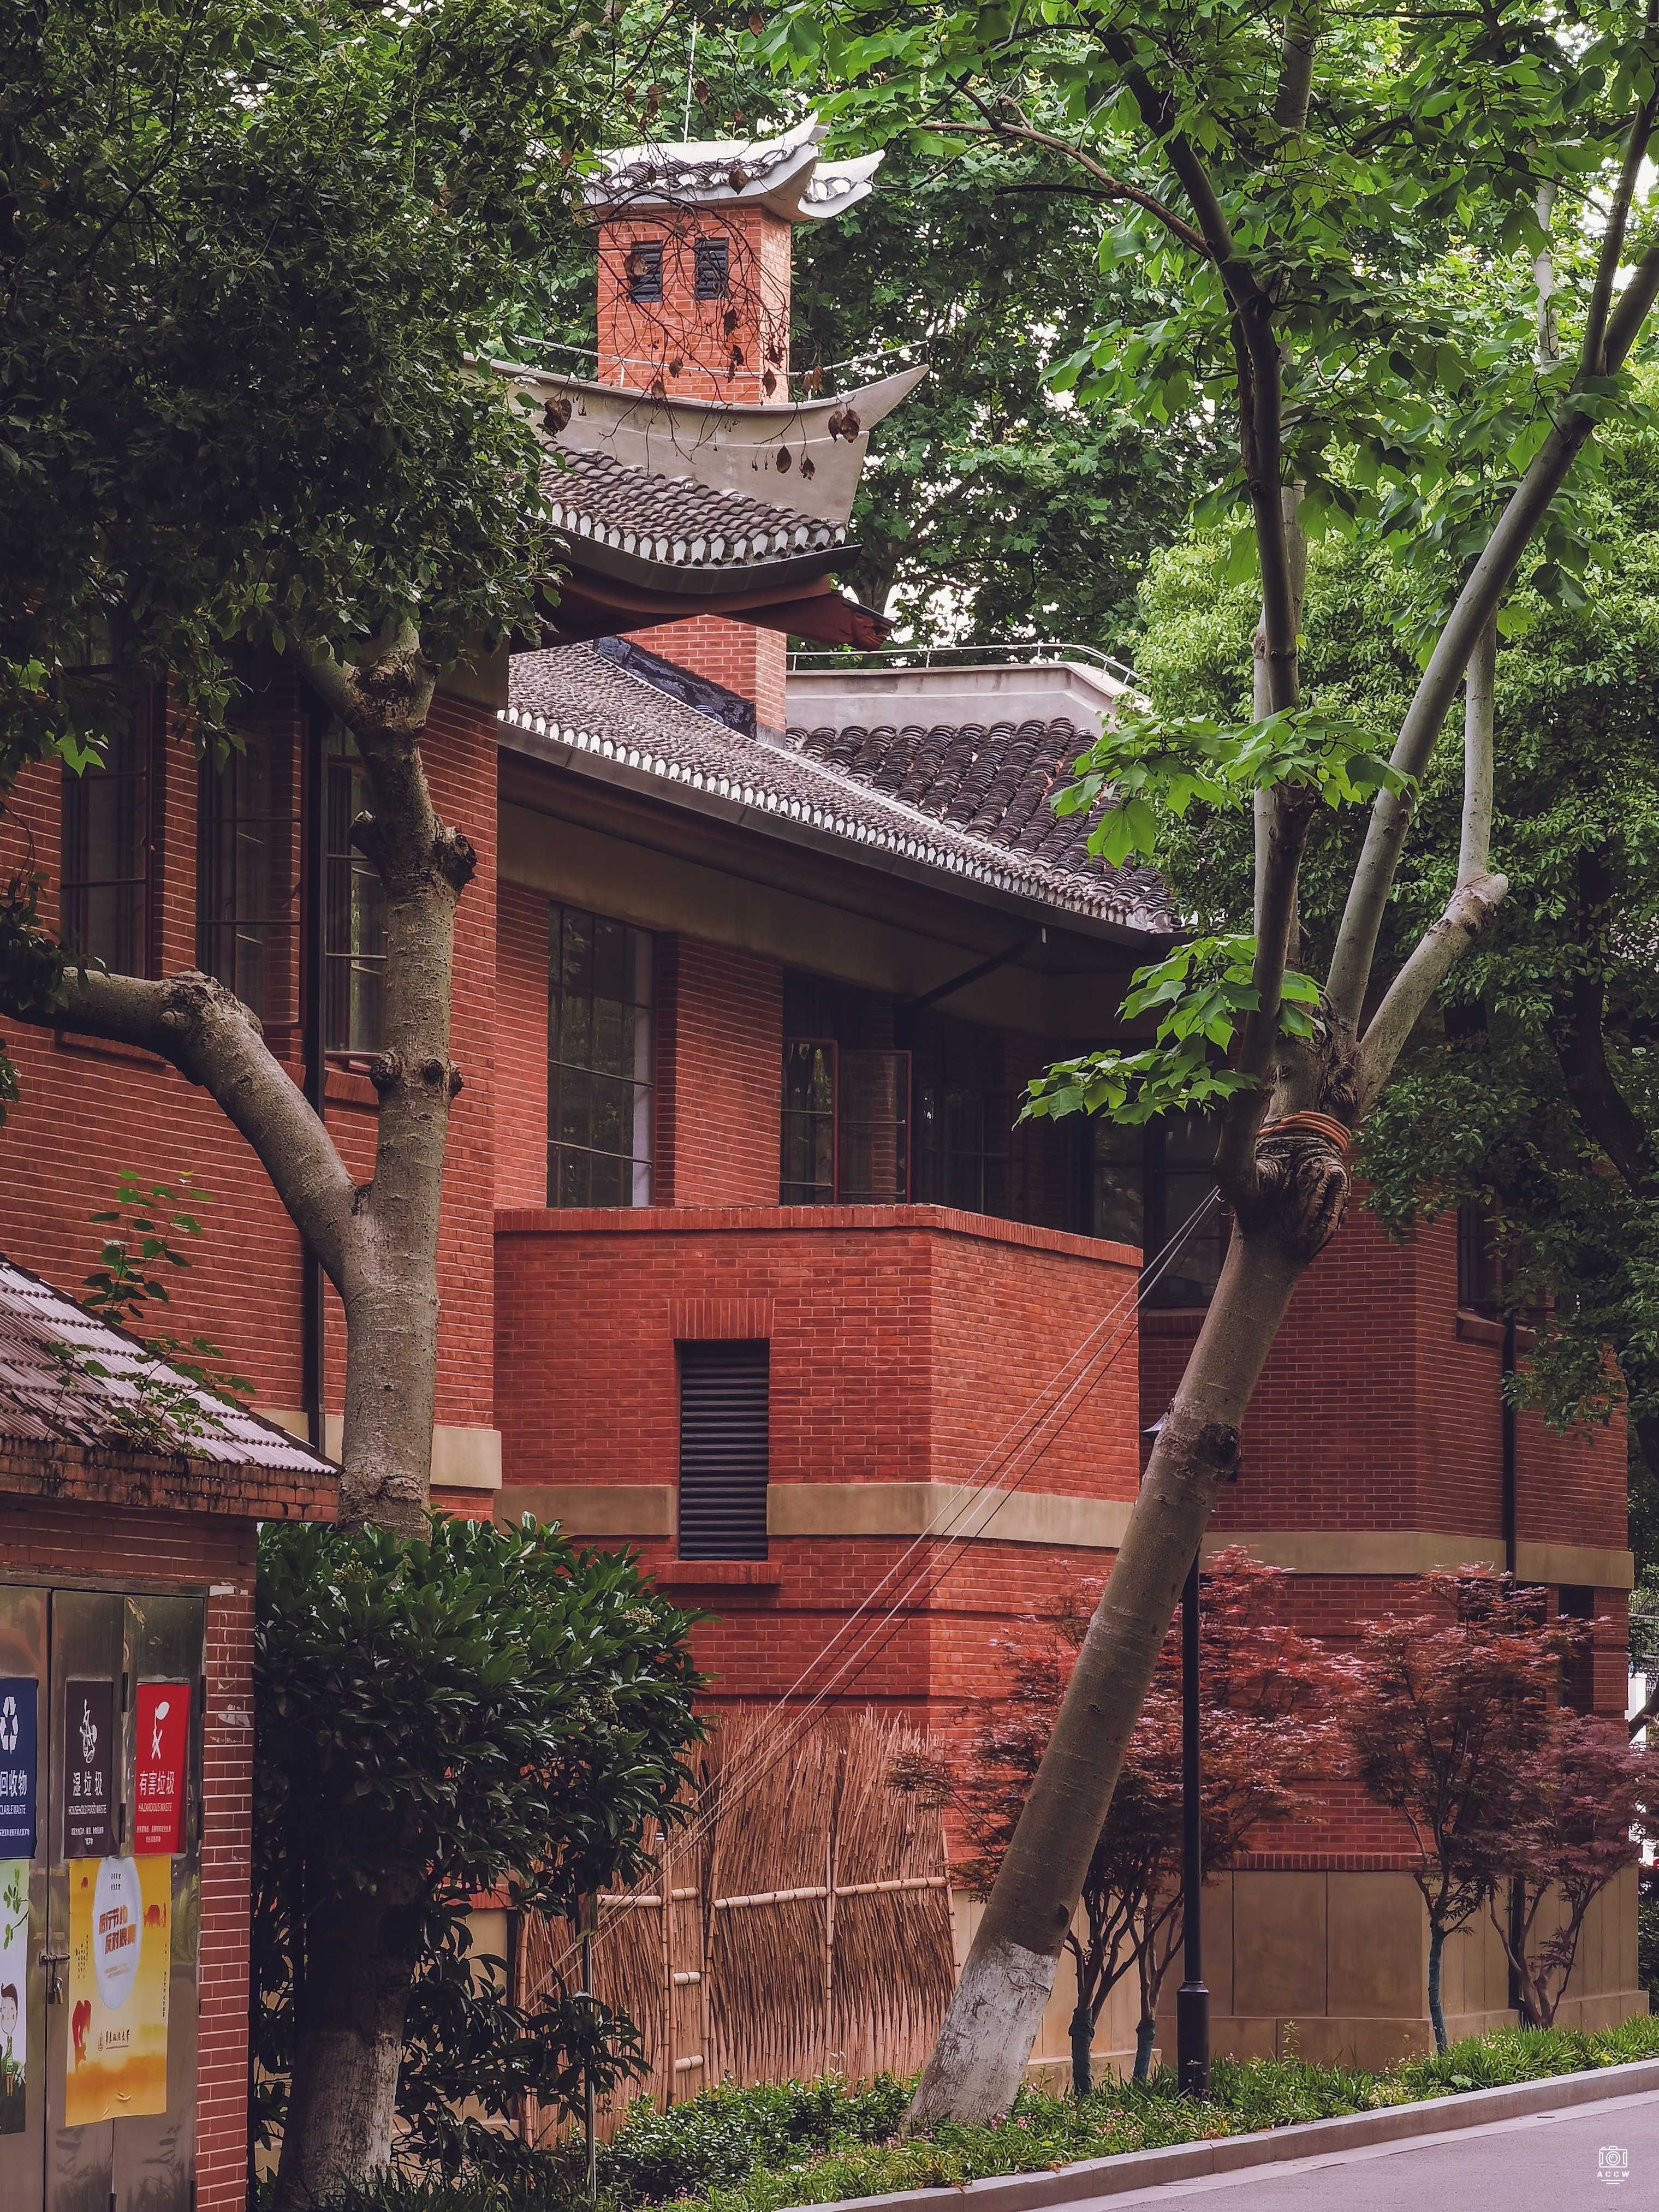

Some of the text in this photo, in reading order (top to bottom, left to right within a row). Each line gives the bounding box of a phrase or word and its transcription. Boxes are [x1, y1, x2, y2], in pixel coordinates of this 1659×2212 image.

[0, 1769, 27, 1797] 回收物
[73, 1771, 103, 1796] 湿垃圾
[139, 1770, 175, 1795] 有害垃圾
